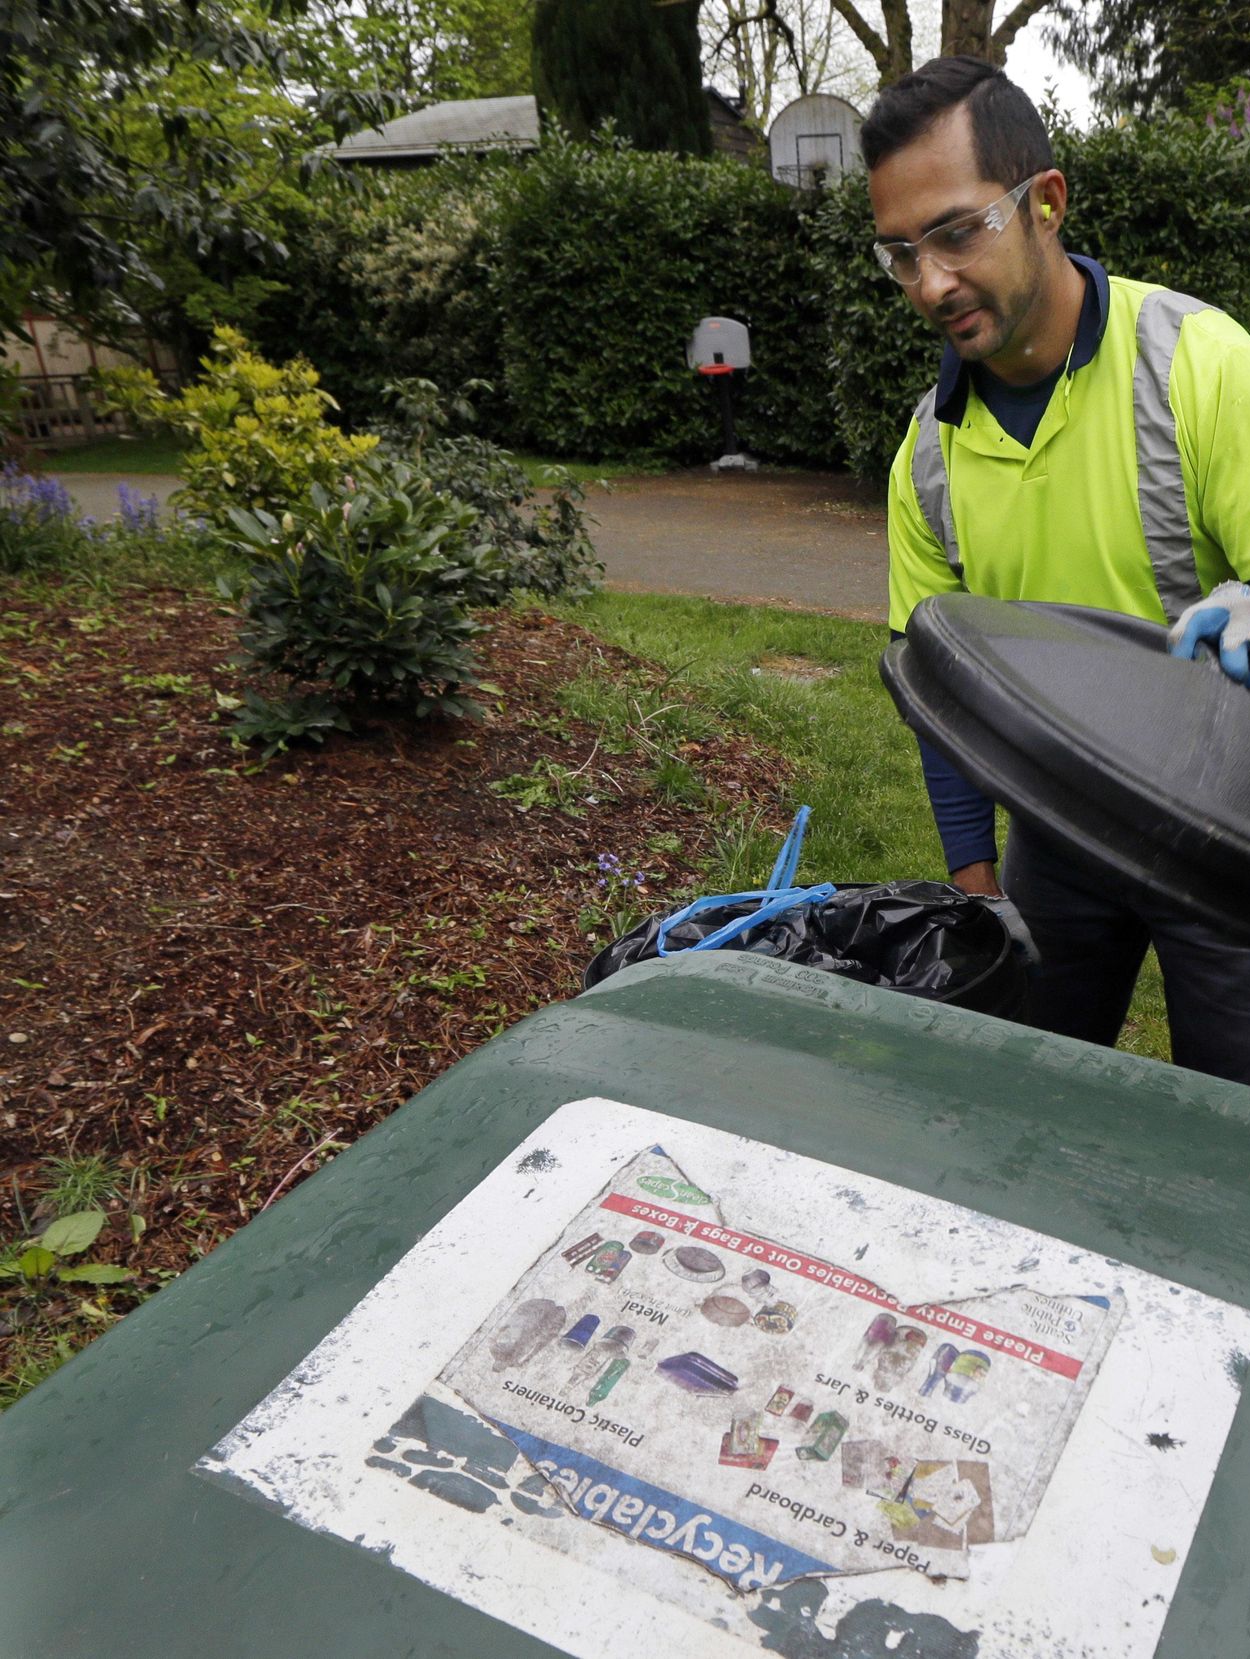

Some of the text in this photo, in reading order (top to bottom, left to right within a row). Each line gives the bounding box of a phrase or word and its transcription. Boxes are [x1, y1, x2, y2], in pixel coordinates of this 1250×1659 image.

[632, 1204, 679, 1228] Boxes
[700, 1226, 742, 1249] Bags
[743, 1241, 763, 1257] of
[768, 1250, 802, 1270] Out
[620, 1300, 669, 1326] Metal
[916, 1304, 976, 1337] Empty
[1021, 1303, 1061, 1327] Public
[1032, 1295, 1083, 1321] Utilities
[1029, 1319, 1074, 1345] Seattle
[983, 1330, 1044, 1364] Please
[501, 1380, 644, 1447] Plastic Containers
[814, 1373, 991, 1455] Glass Bottles & Jars
[745, 1483, 931, 1573] Paper & Cardboard
